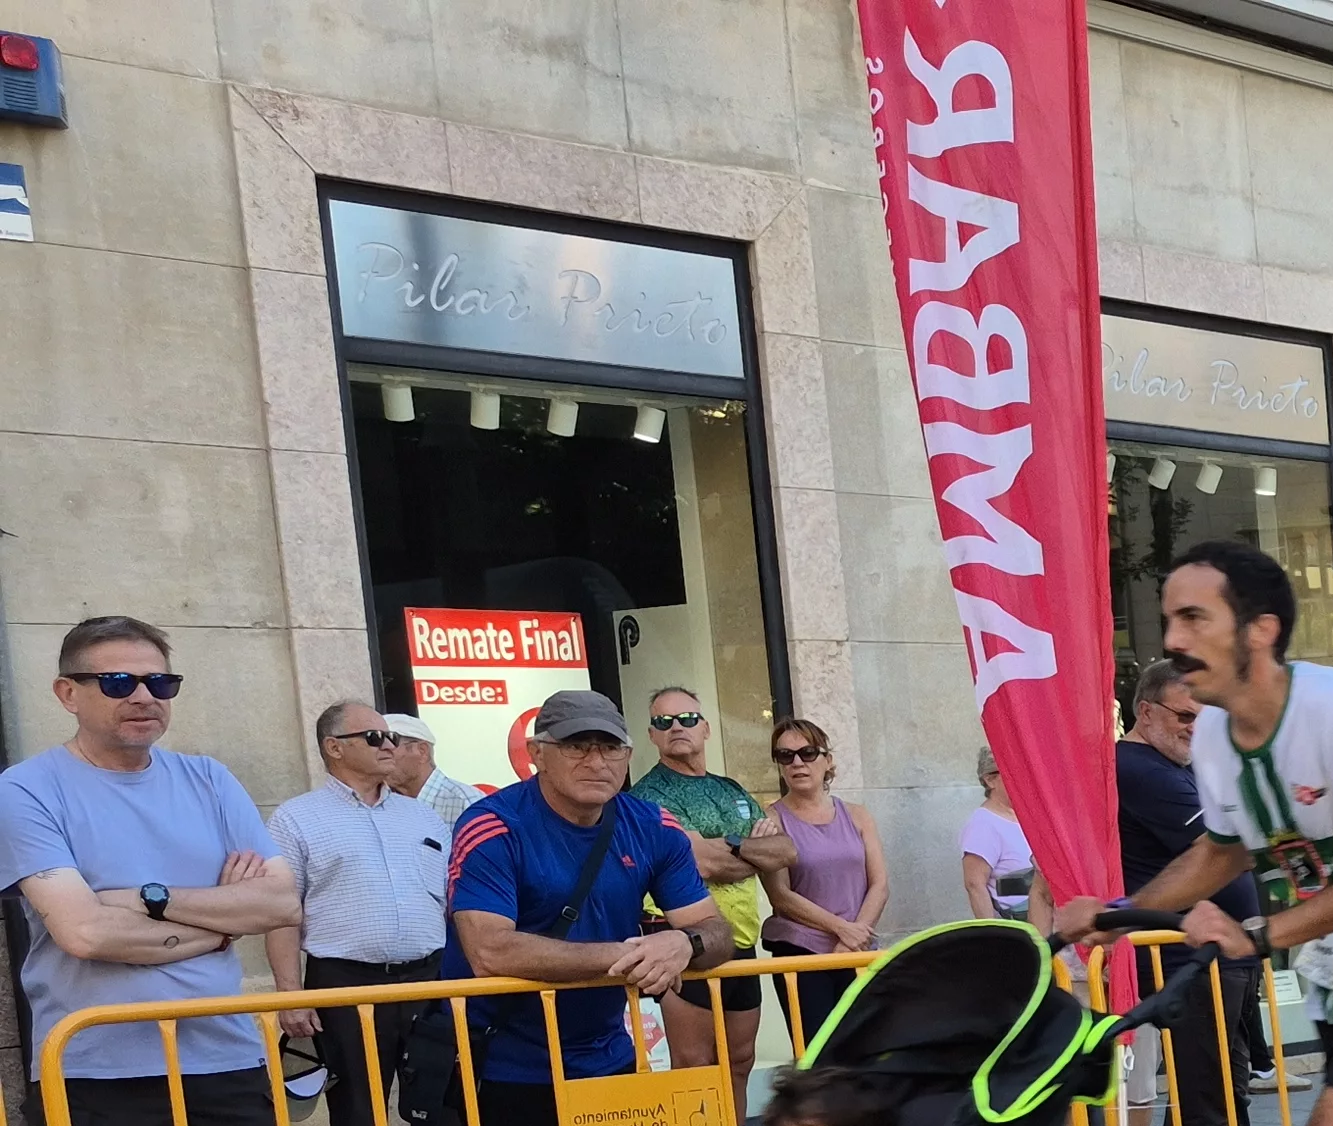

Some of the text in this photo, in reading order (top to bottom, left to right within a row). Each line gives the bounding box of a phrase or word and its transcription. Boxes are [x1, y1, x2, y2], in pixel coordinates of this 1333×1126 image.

[356, 240, 728, 347] Pilar Prieto
[1210, 359, 1319, 418] Prieto
[412, 616, 582, 662] Remate Final
[421, 681, 504, 703] Desde:
